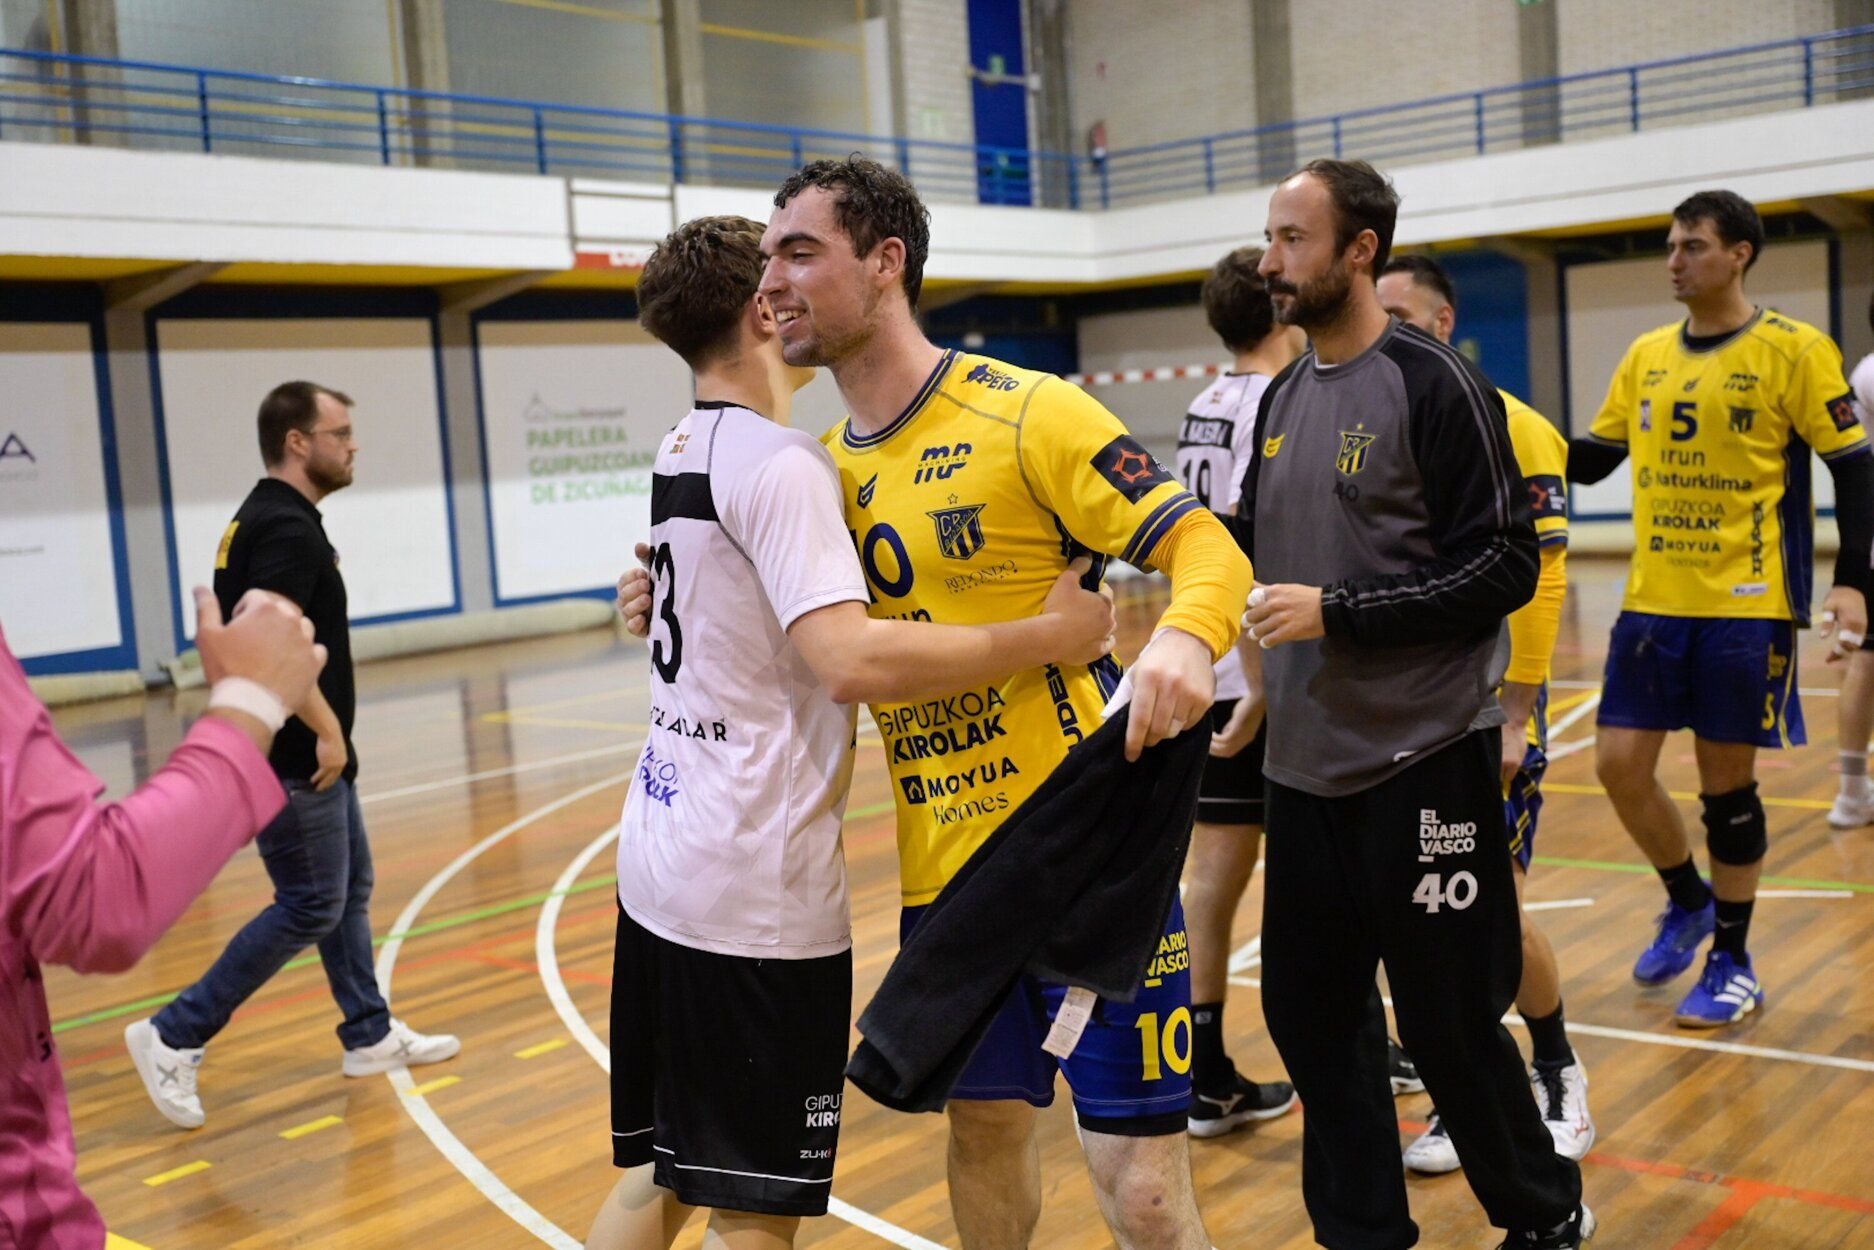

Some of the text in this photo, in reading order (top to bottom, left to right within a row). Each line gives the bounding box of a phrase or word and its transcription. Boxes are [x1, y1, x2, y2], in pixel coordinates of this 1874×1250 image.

[527, 426, 628, 448] PAPELERA
[1671, 402, 1698, 441] 5
[529, 452, 656, 477] GUIPUZCOAN
[531, 471, 651, 505] DE ZICUÑAG
[1665, 541, 1722, 553] MOYUA
[944, 559, 1016, 589] REDONDO
[649, 542, 683, 684] 3
[878, 686, 1006, 736] GIPUZKOA
[893, 713, 1007, 764] KIROLAK
[927, 757, 1020, 798] MOYUA
[933, 792, 1010, 826] Homes
[1420, 808, 1441, 824] EL
[1419, 821, 1477, 840] DIARIO
[1419, 837, 1476, 855] VASCO
[1411, 870, 1479, 914] 40
[1156, 930, 1187, 955] ARIO
[1134, 1006, 1193, 1081] 10
[805, 1092, 844, 1111] GIPU
